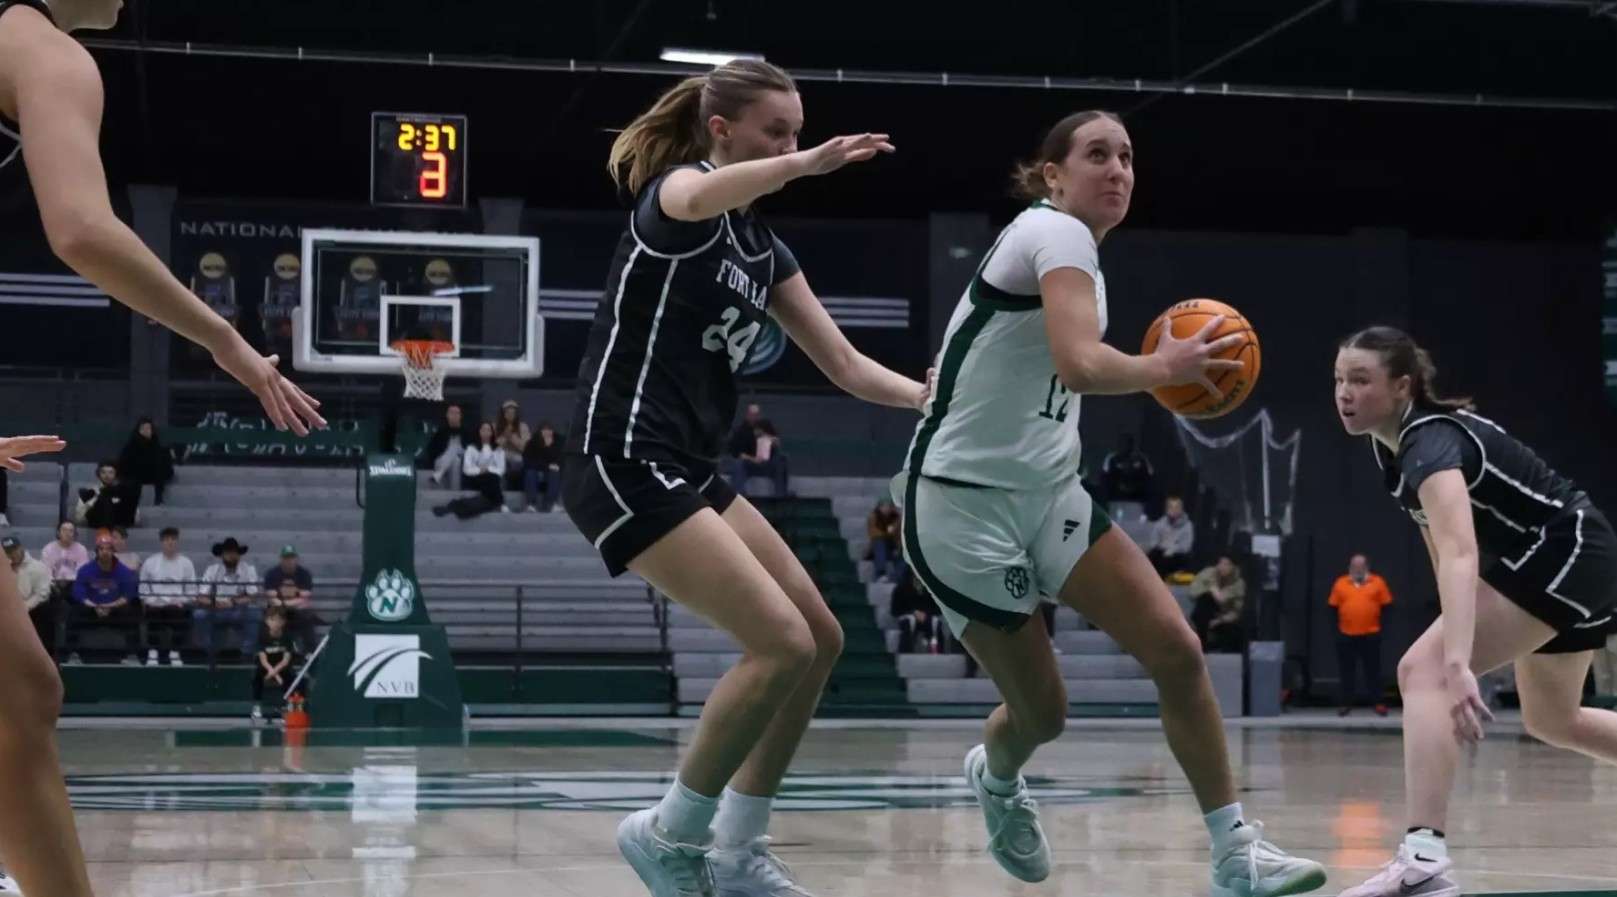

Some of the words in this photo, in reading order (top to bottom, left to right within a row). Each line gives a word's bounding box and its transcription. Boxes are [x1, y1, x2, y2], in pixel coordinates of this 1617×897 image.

[397, 122, 458, 152] 2:37
[419, 151, 448, 199] 3
[715, 258, 750, 299] FORT
[701, 305, 761, 374] 24
[379, 596, 398, 614] N
[377, 682, 415, 694] NVB
